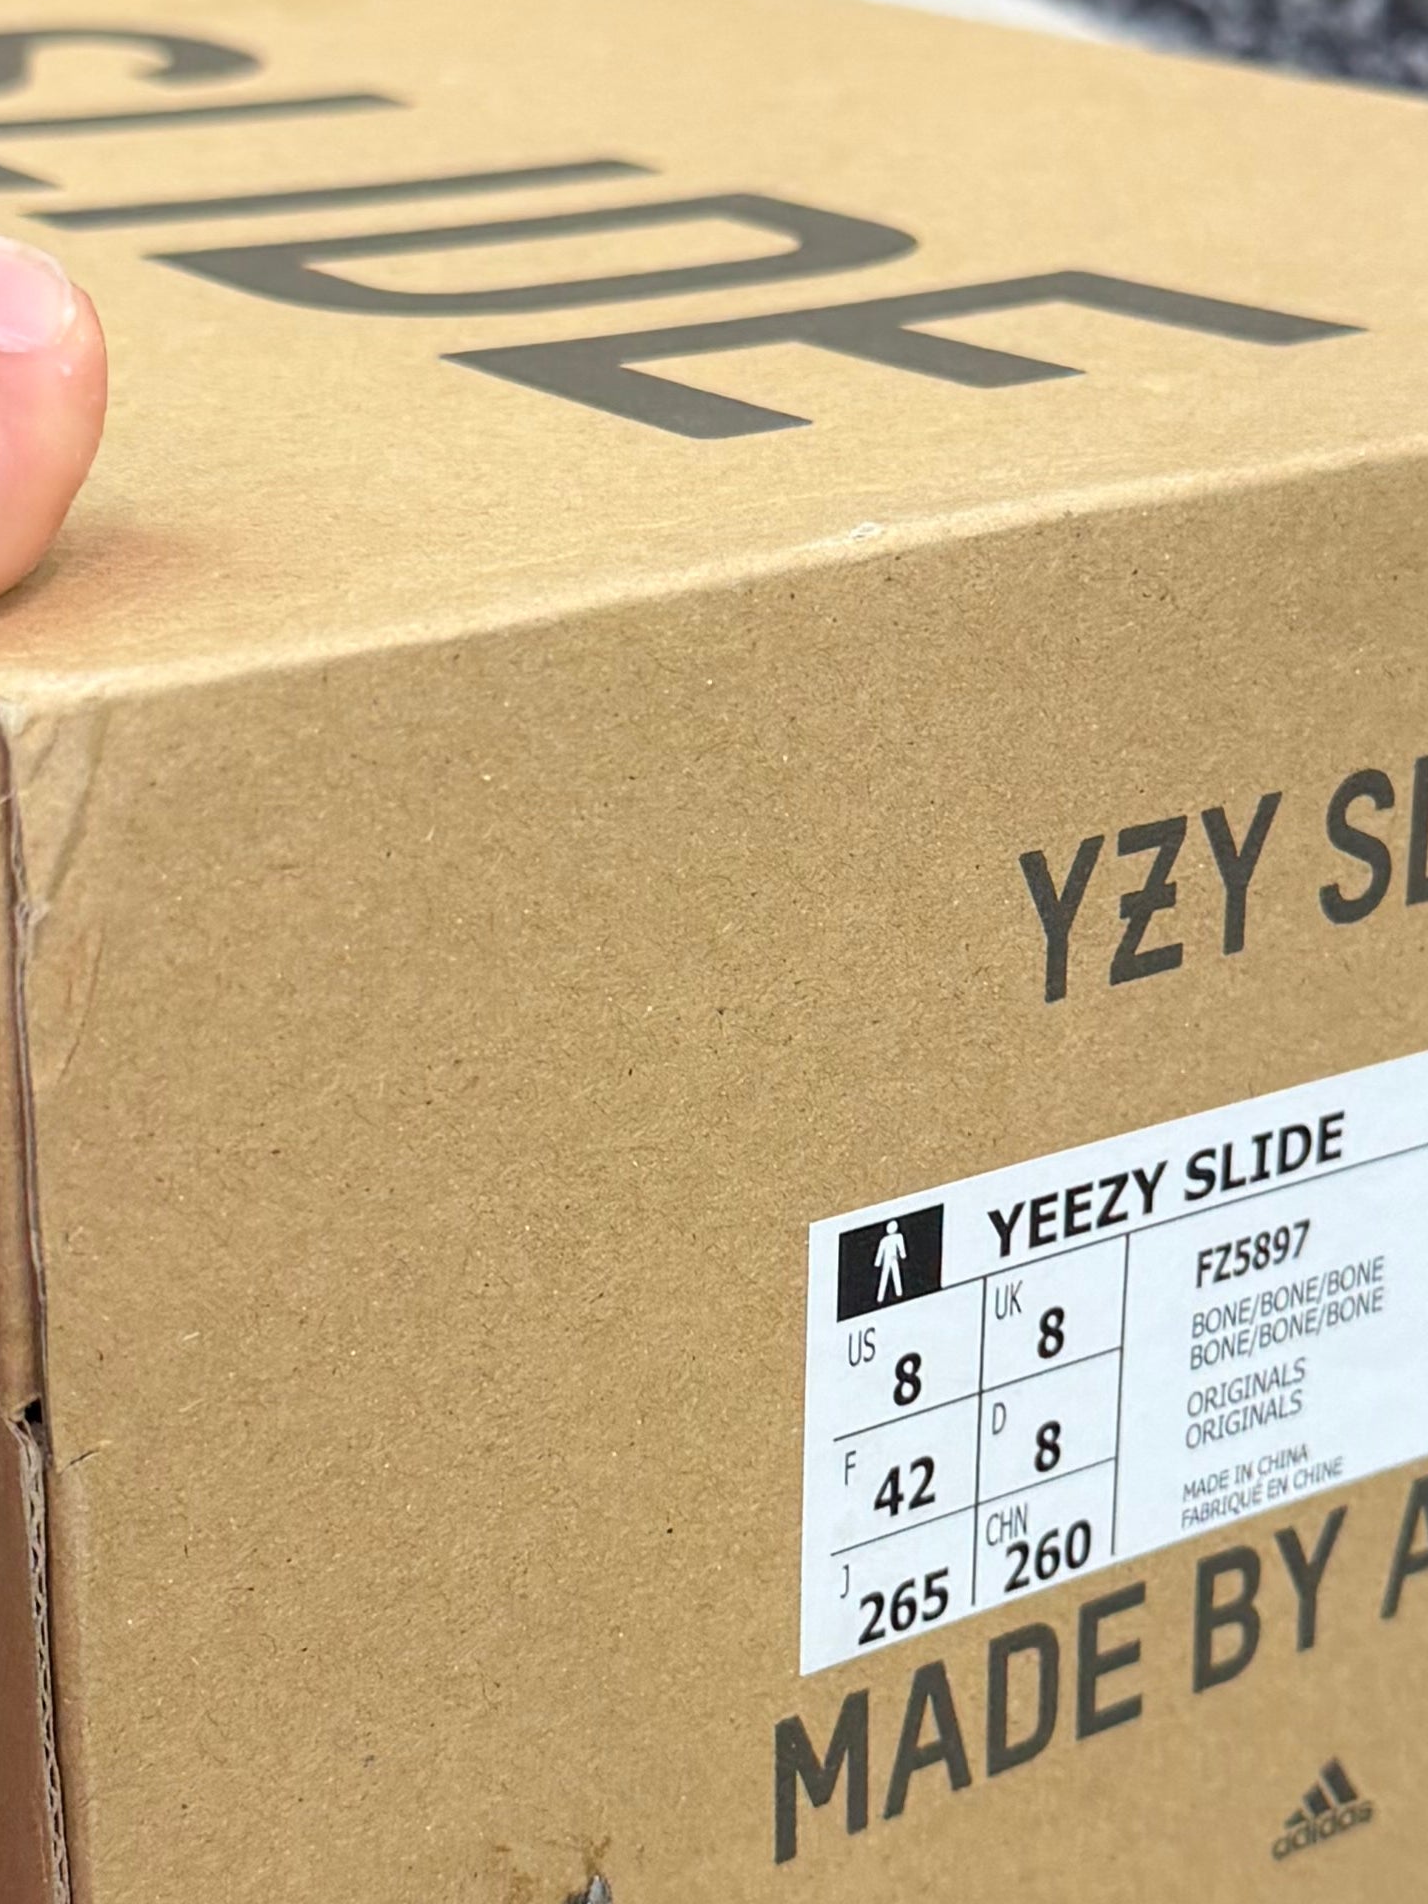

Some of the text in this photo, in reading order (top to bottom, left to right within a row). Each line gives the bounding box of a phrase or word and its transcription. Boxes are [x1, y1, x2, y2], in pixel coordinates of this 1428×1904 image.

[987, 1112, 1347, 1259] YEEZY SLIDE
[1195, 1217, 1311, 1289] FZ5897
[994, 1279, 1024, 1321] UK
[1189, 1286, 1385, 1371] BONE/BONE/BONE
[1190, 1256, 1385, 1340] BONE/BONE/BONE
[847, 1326, 877, 1368] US
[1036, 1306, 1066, 1360] 8
[892, 1351, 923, 1407] 8
[1186, 1356, 1307, 1418] ORIGINALS
[991, 1401, 1007, 1436] D
[1033, 1419, 1062, 1474] 8
[1184, 1389, 1304, 1450] ORIGINALS
[844, 1450, 857, 1487] F
[872, 1455, 937, 1518] 42
[1182, 1443, 1309, 1504] MADE IN CHINA
[1266, 1474, 1289, 1500] EN
[1292, 1455, 1344, 1491] CHINE
[985, 1502, 1029, 1548] CHN
[839, 1564, 850, 1599] J
[1003, 1519, 1092, 1594] 260
[857, 1566, 950, 1647] 265
[772, 1580, 1148, 1866] MADE
[1191, 1505, 1349, 1694] BY
[1272, 1800, 1374, 1861] adidas
